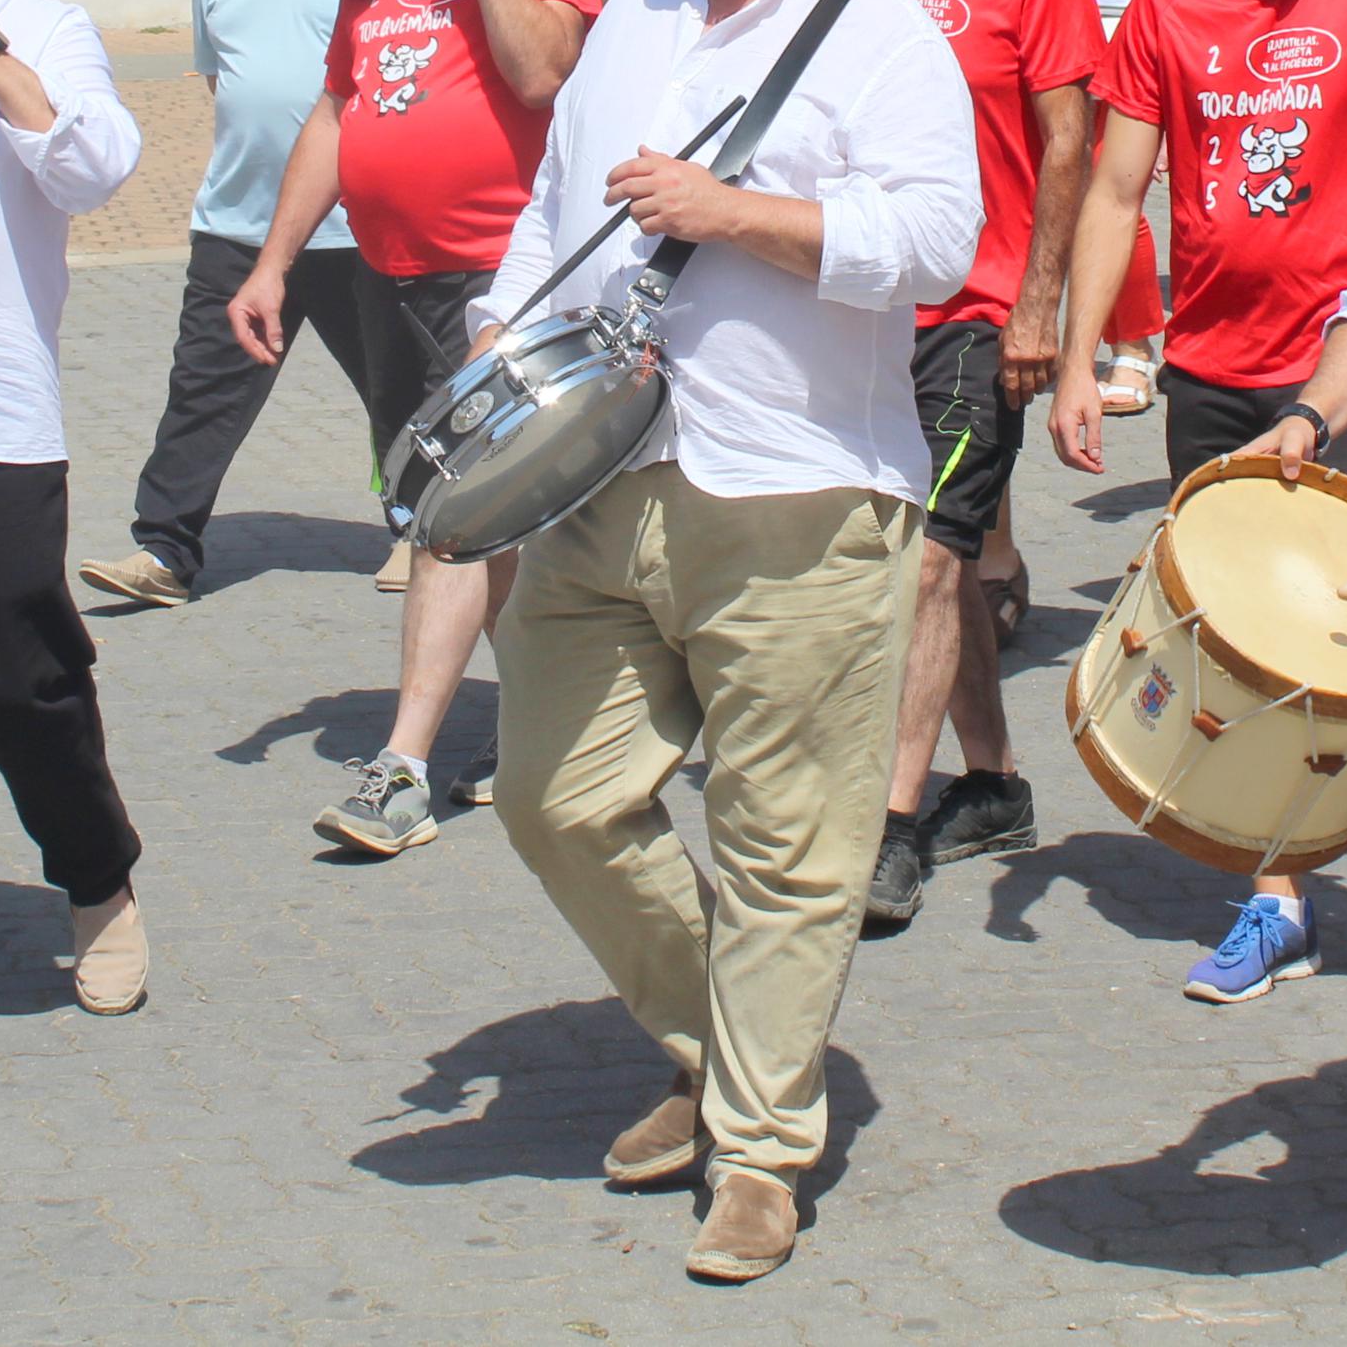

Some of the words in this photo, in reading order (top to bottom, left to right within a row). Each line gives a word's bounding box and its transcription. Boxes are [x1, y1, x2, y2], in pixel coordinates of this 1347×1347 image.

[358, 7, 453, 44] TORQUEMADA
[355, 56, 369, 81] 2
[1207, 45, 1223, 75] 2
[1270, 62, 1279, 73] AL
[1279, 56, 1324, 71] ENCIERRO!
[1273, 46, 1312, 61] CAMISETA
[1197, 83, 1323, 121] TORQUEMADA
[1207, 135, 1223, 166] 2
[1204, 180, 1219, 210] 5
